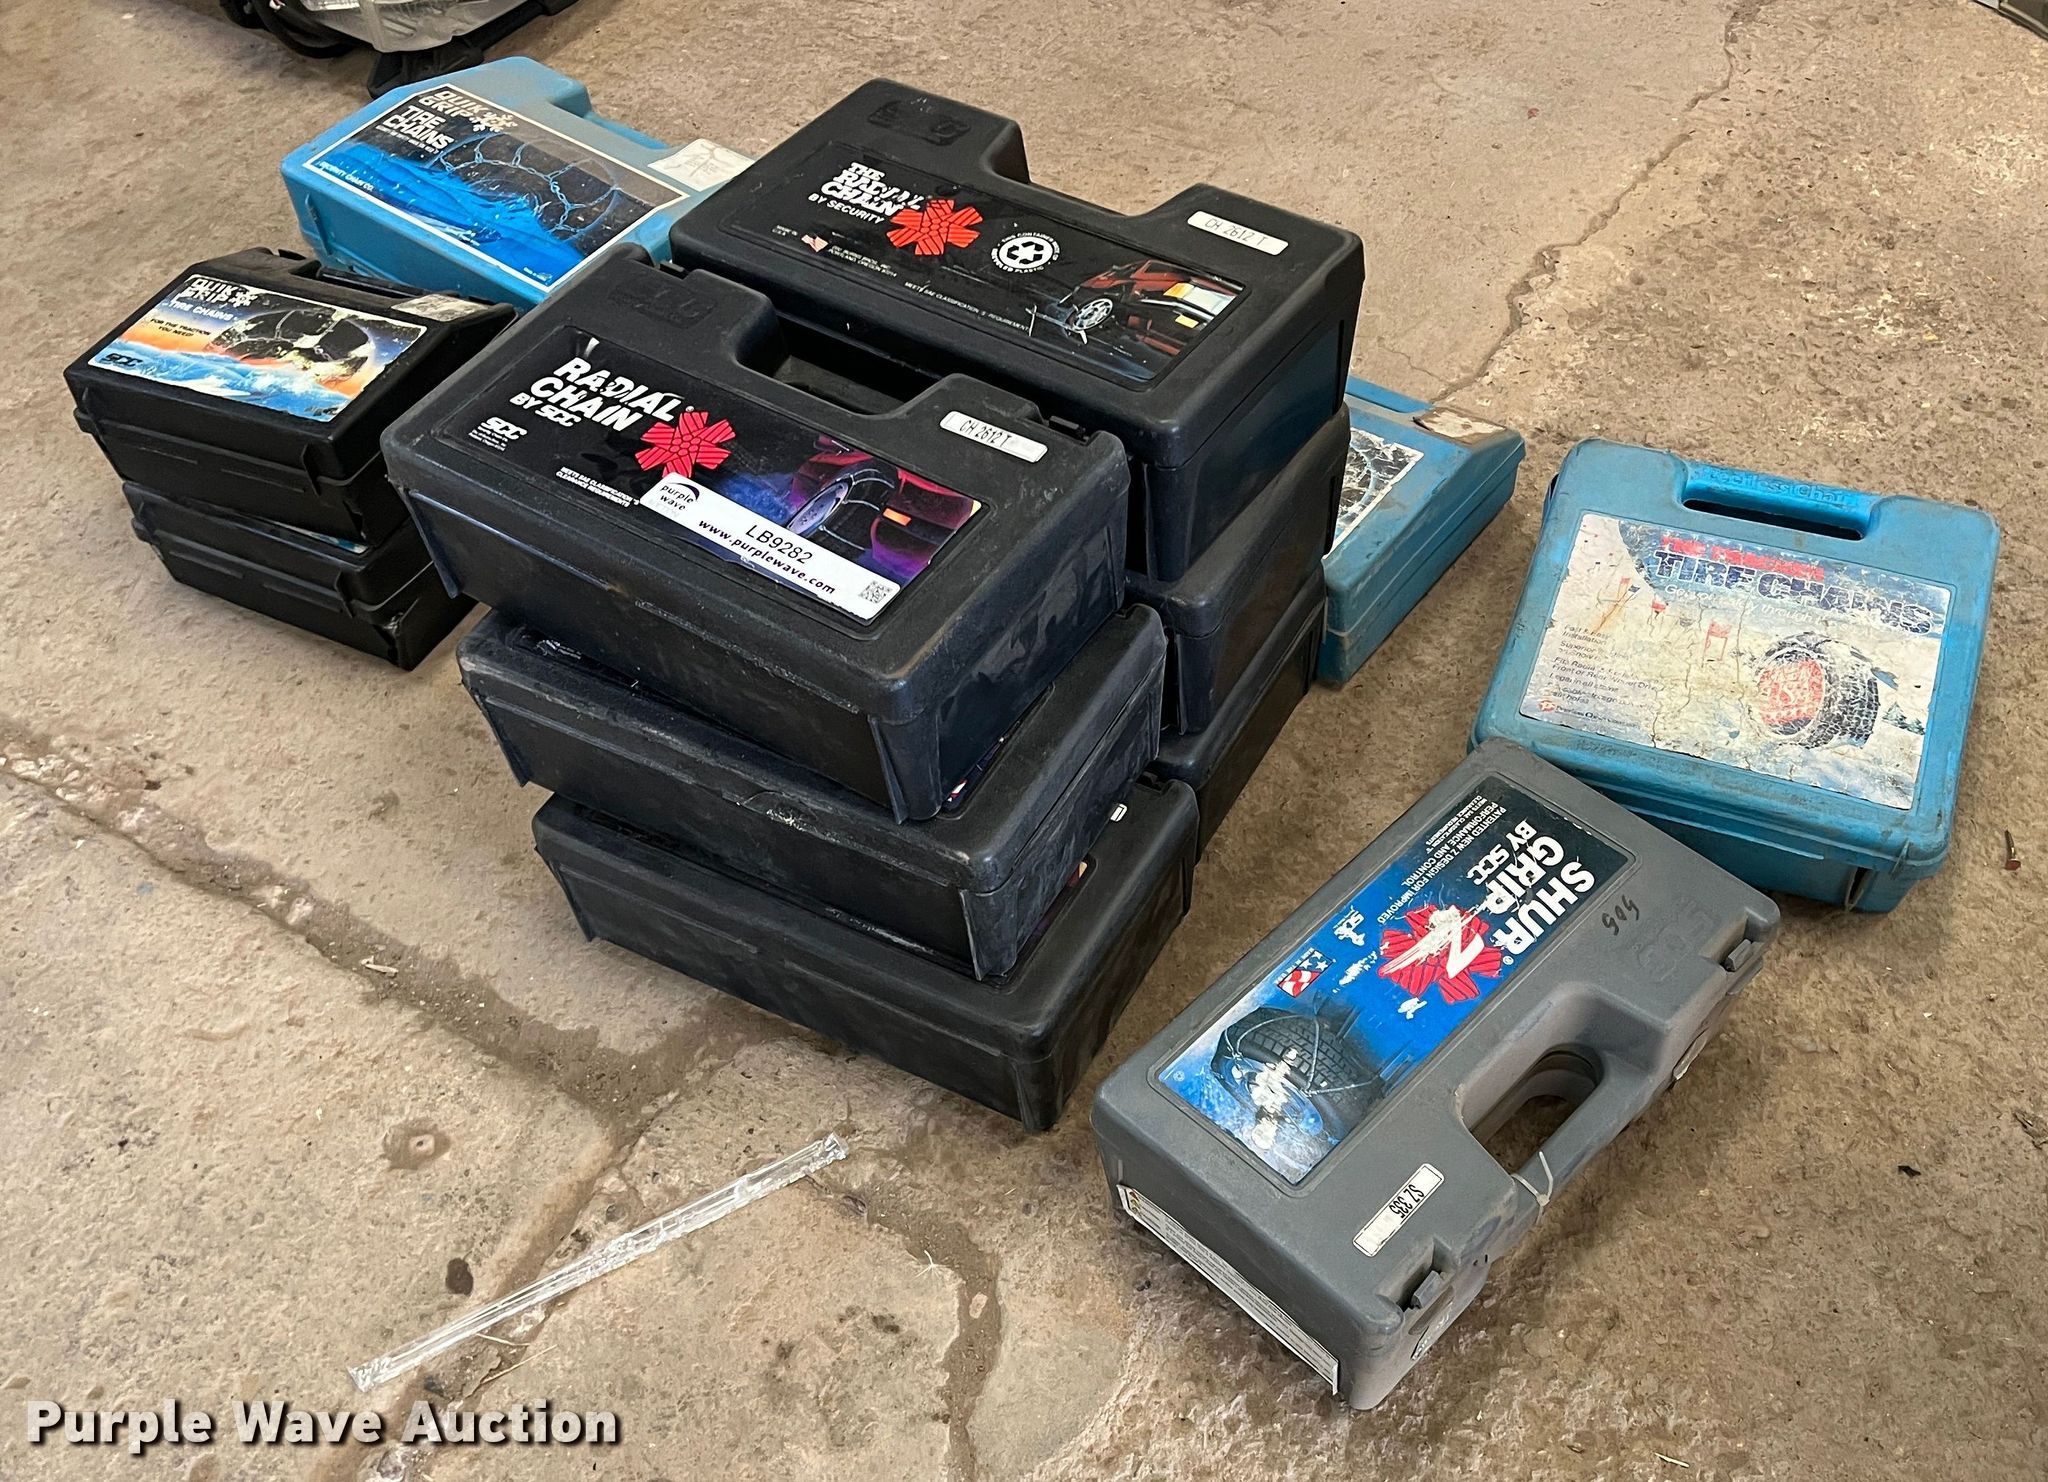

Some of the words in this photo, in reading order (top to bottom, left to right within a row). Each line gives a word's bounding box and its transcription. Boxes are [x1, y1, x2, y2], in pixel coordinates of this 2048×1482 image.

[407, 105, 446, 129] TIRE
[419, 95, 474, 118] GRIP
[434, 90, 489, 114] QUIK
[382, 114, 455, 150] CHAINS
[848, 162, 885, 181] THE
[821, 181, 903, 216] CHAIN
[833, 169, 924, 210] RADIAL
[808, 193, 827, 204] BY
[827, 200, 885, 224] SECURITY
[1205, 218, 1223, 230] CH
[1224, 225, 1255, 241] 2612
[1257, 237, 1268, 245] T
[170, 300, 192, 312] TIRE
[192, 305, 234, 322] CHAINS
[530, 377, 643, 432] CHAIN
[553, 357, 682, 422] RADIAL
[509, 392, 544, 410] BY
[534, 404, 582, 428] SCC
[481, 416, 528, 440] SCC
[960, 420, 978, 435] CH
[975, 426, 1003, 444] 2612
[1000, 434, 1012, 447] T
[660, 483, 695, 503] purple
[660, 493, 687, 512] wave
[699, 518, 836, 595] www.purplewave.com
[745, 524, 814, 564] LB9282
[1654, 550, 1756, 589] TIRE
[1757, 572, 1933, 635] CHAINS
[1447, 801, 1498, 847] PERFORMANCE
[1471, 805, 1507, 837] PATENTED
[1505, 820, 1537, 852] BY
[1433, 844, 1450, 859] AND
[1450, 848, 1459, 857] Z
[1456, 834, 1474, 851] NEW
[1401, 856, 1437, 888] CONTROL
[1426, 854, 1453, 878] DESIGN
[1467, 844, 1511, 886] SCC
[1487, 836, 1565, 915] GRIP
[1411, 876, 1429, 892] FOR
[1374, 889, 1415, 925] IMPROVED
[1493, 861, 1596, 956] SHUR
[1389, 1196, 1413, 1218] 335
[1403, 1184, 1424, 1203] SZ
